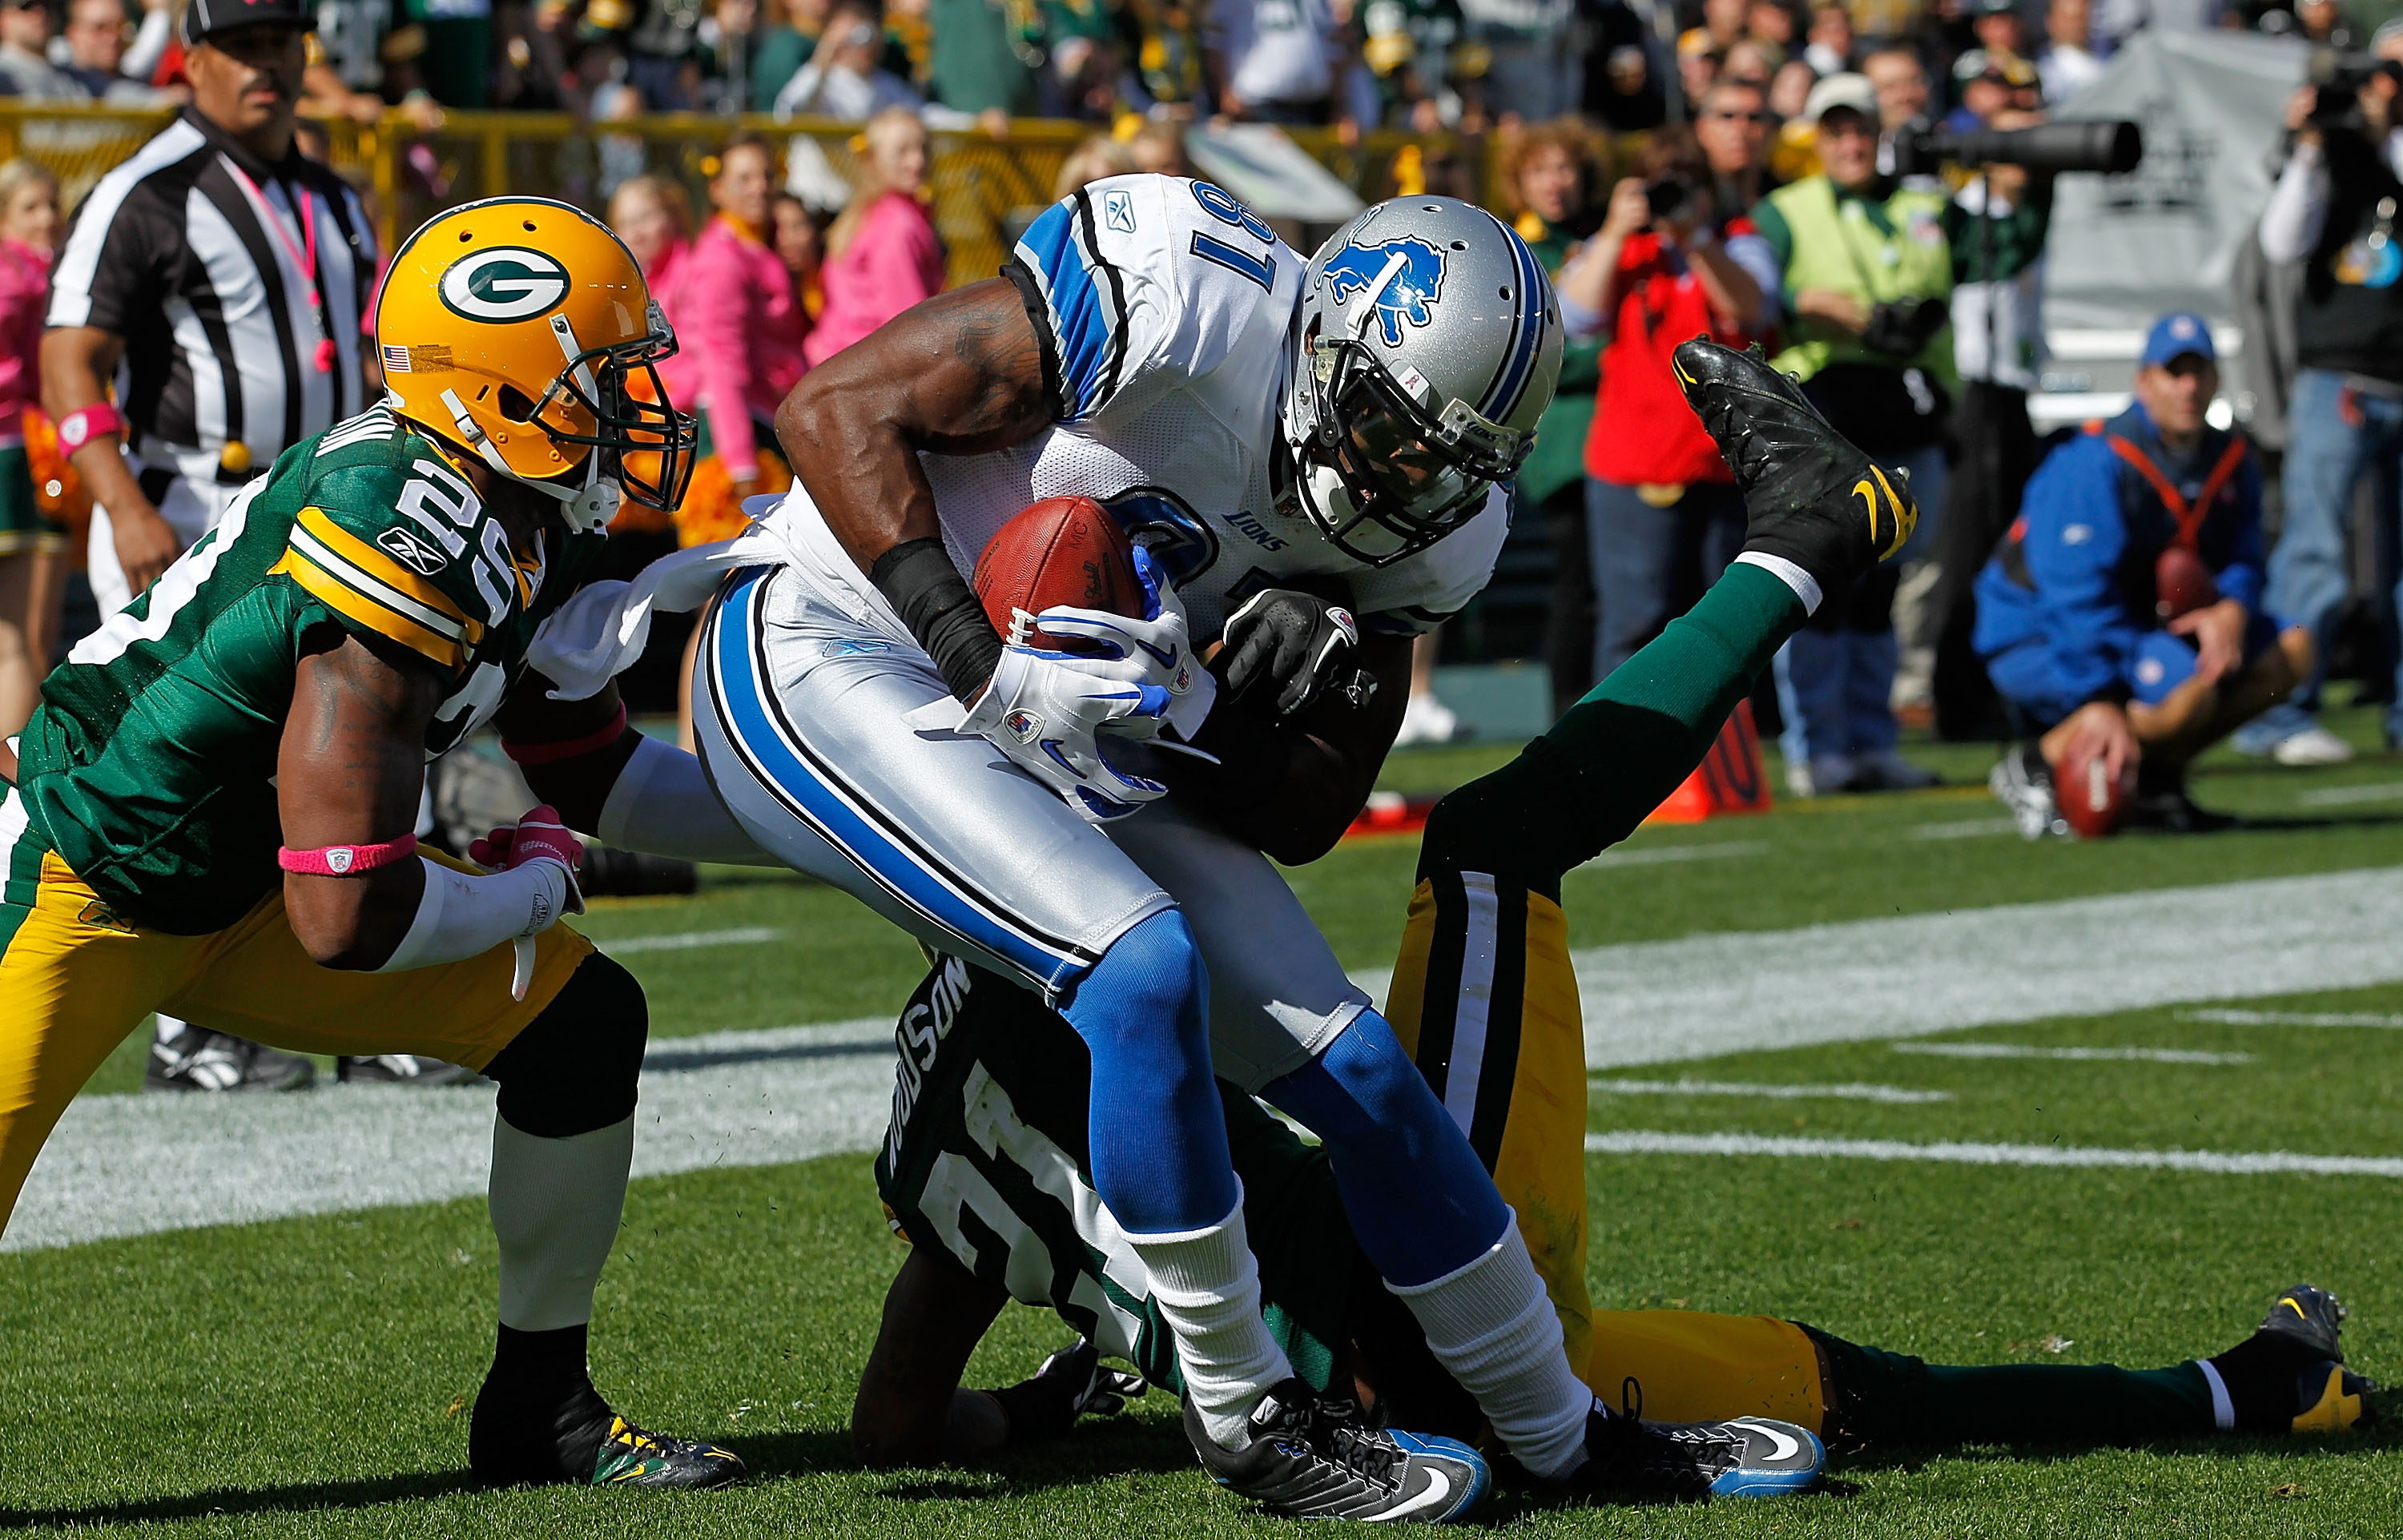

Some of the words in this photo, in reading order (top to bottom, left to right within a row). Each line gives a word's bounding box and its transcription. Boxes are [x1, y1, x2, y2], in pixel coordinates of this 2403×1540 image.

[444, 250, 564, 318] G
[1189, 179, 1277, 296] 81
[396, 458, 515, 629] 29
[919, 1058, 1150, 1359] 21
